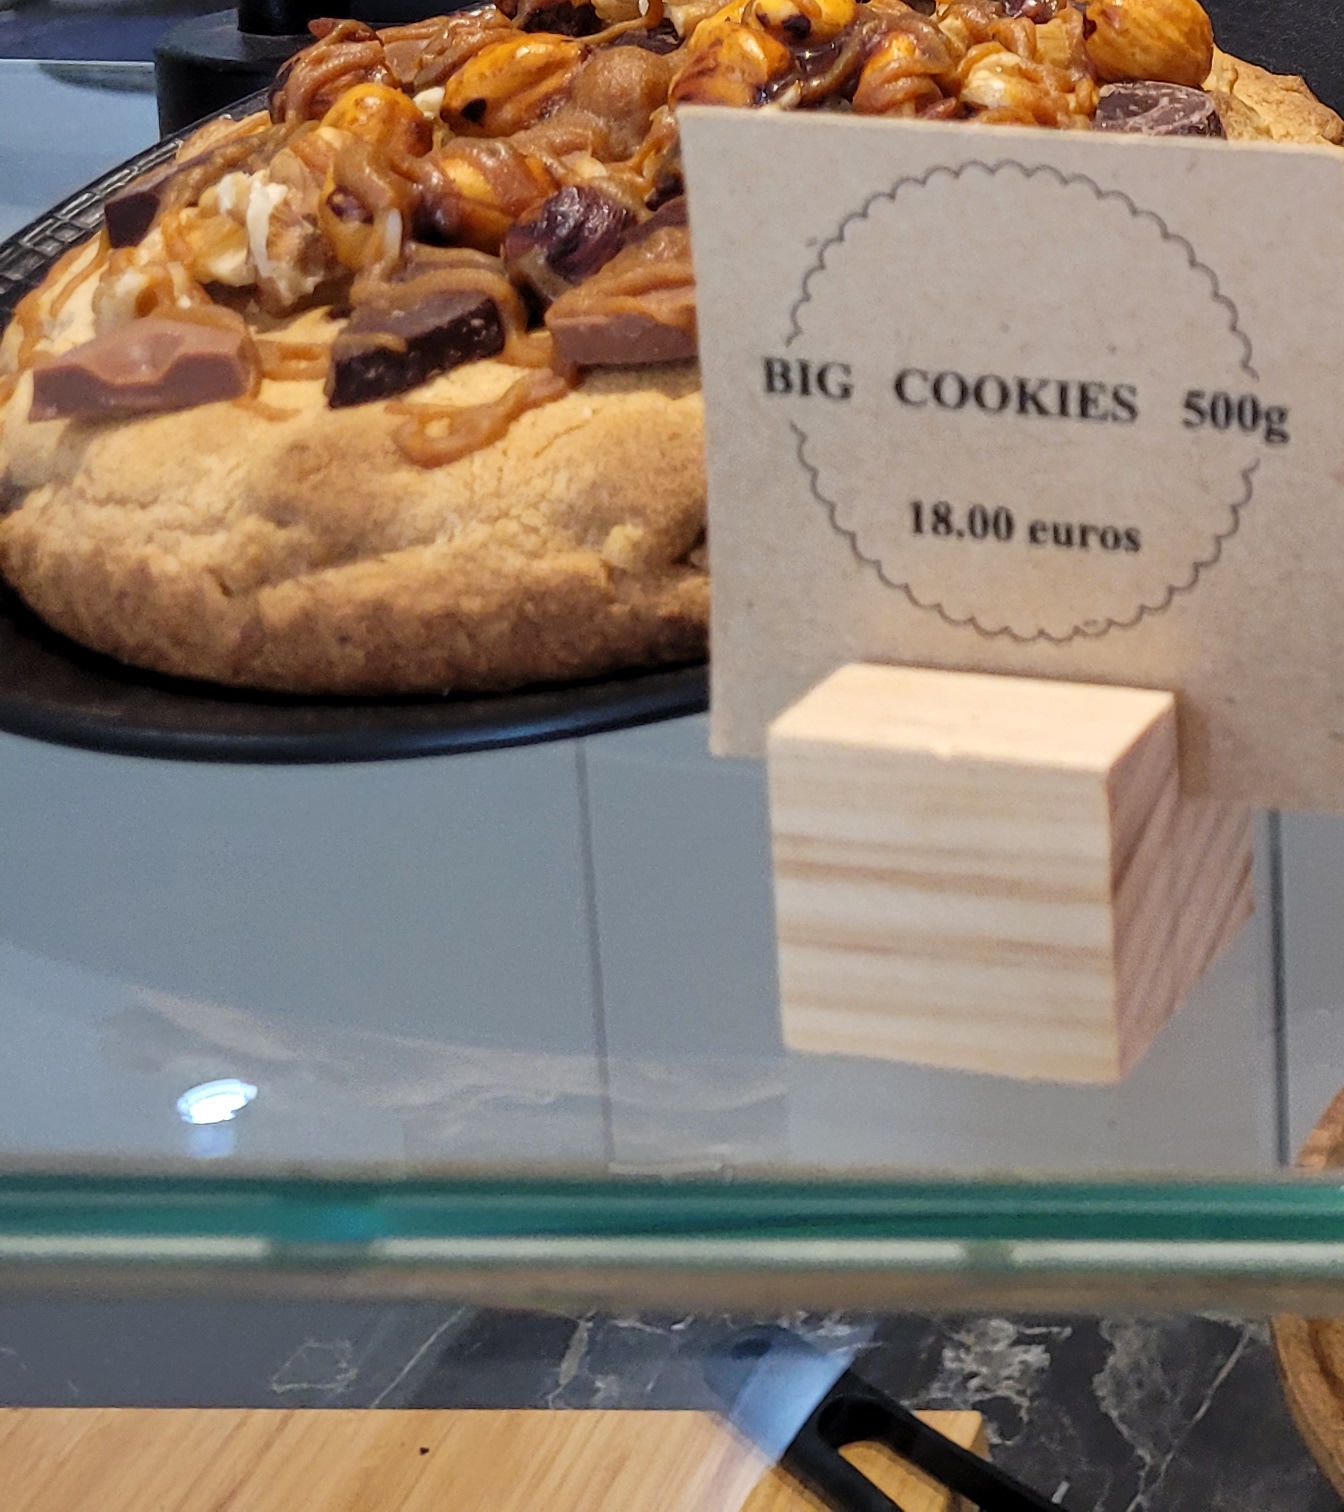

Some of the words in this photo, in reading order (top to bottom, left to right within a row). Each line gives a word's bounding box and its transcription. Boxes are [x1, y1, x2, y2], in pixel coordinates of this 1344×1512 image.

[763, 356, 855, 401] BIG
[893, 367, 1139, 424] COOKIES
[1181, 389, 1290, 445] 500g
[908, 500, 1015, 541] 18.00
[1028, 517, 1142, 554] euros
